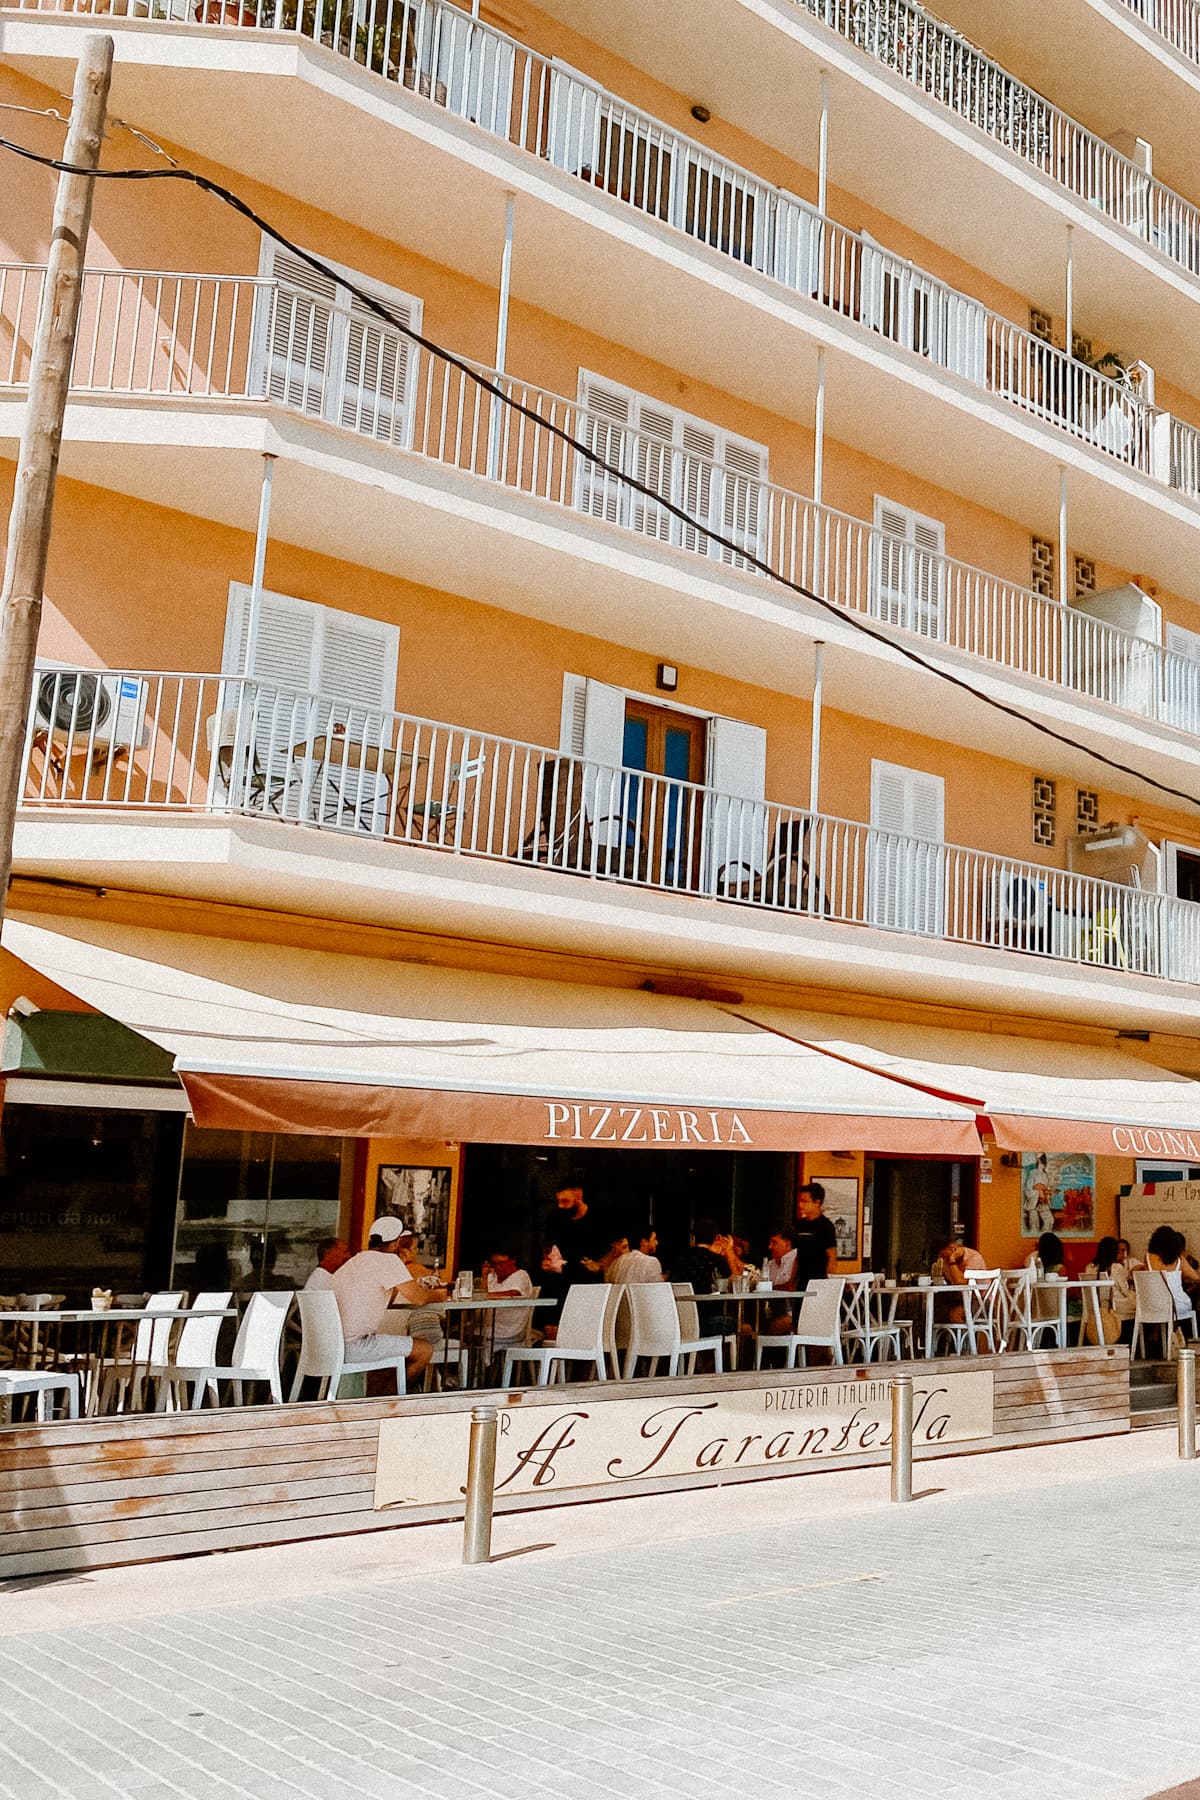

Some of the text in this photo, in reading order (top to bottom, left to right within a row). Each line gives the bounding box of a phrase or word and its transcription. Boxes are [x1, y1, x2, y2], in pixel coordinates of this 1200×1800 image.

[543, 1102, 755, 1144] PIZZERIA
[1111, 1126, 1200, 1158] CUCINA
[764, 1380, 894, 1412] PIZZERIA ITALIANA
